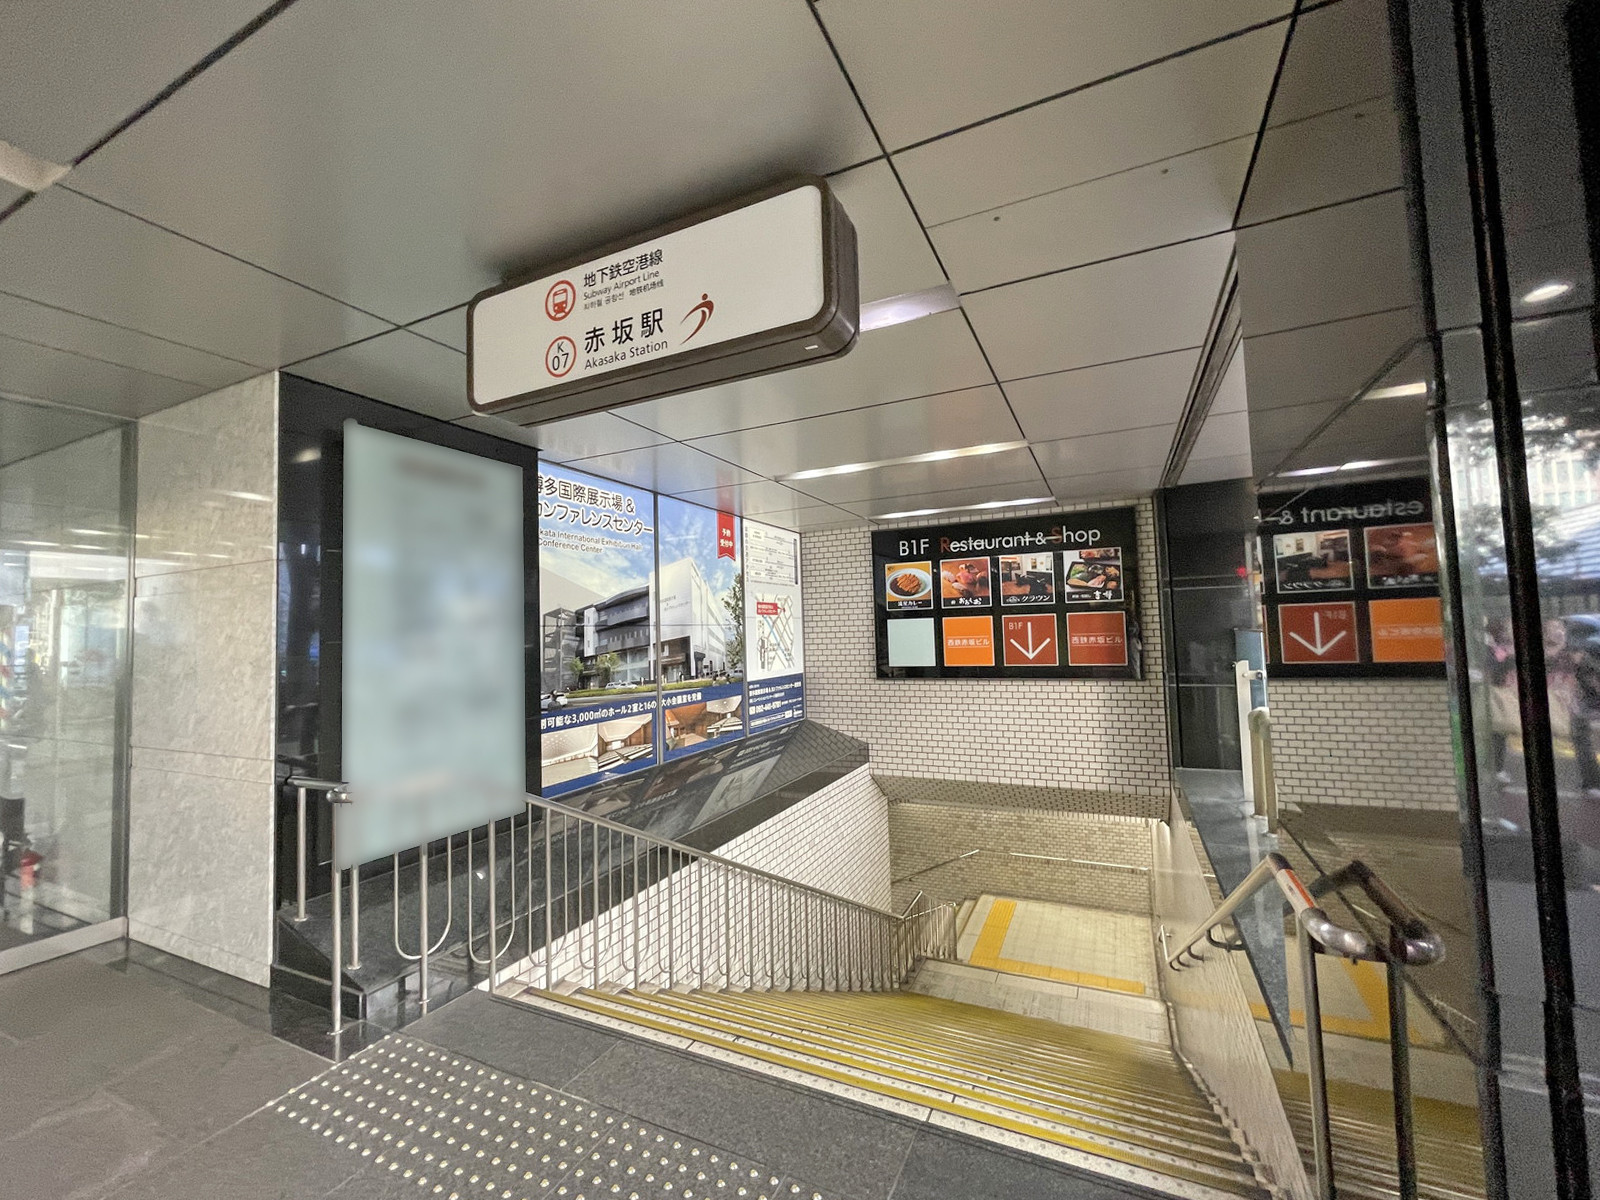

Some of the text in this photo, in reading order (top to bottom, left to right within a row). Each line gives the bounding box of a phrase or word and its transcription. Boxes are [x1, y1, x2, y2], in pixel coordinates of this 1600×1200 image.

[584, 249, 663, 287] 地下鉄空港線
[584, 270, 660, 300] Subway Airport Line
[585, 308, 663, 353] 赤坂駅
[557, 341, 565, 353] K
[584, 340, 668, 370] Akasaka Station
[552, 353, 569, 371] 07
[626, 499, 635, 513] &
[538, 501, 653, 536] ンファレンスセンター
[538, 538, 603, 553] Conference Center
[557, 531, 600, 545] International
[900, 525, 1101, 556] B1F Restaurant & Shop
[1008, 621, 1023, 630] B1F
[947, 638, 990, 647] 西鉄赤坂ビル
[1071, 635, 1123, 645] 西鉄赤坂ビル
